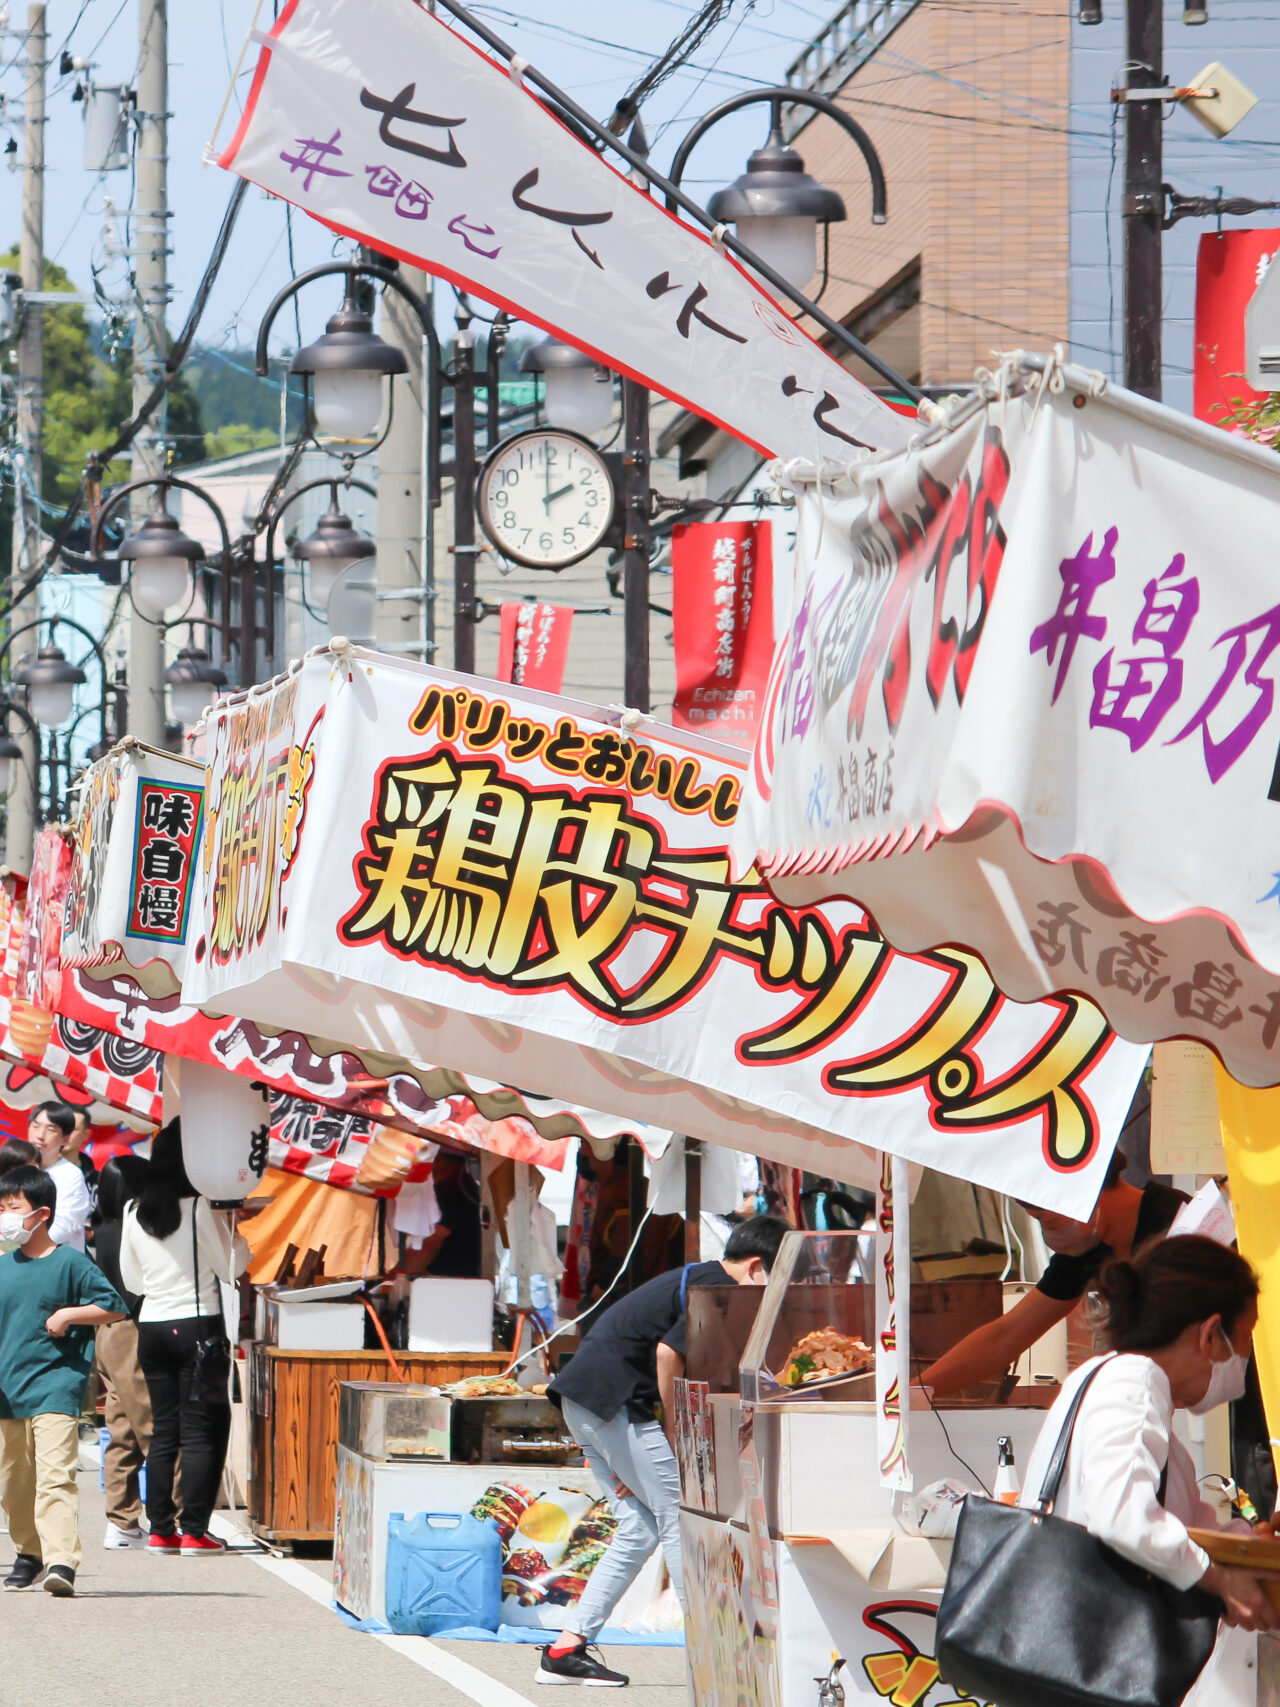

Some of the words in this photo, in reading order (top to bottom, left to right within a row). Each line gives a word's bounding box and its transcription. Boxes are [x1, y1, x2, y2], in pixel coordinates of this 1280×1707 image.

[688, 707, 754, 721] machi
[692, 687, 756, 702] Echizen
[138, 791, 195, 931] 味自慢
[337, 743, 1114, 1173] 鶏皮チップス
